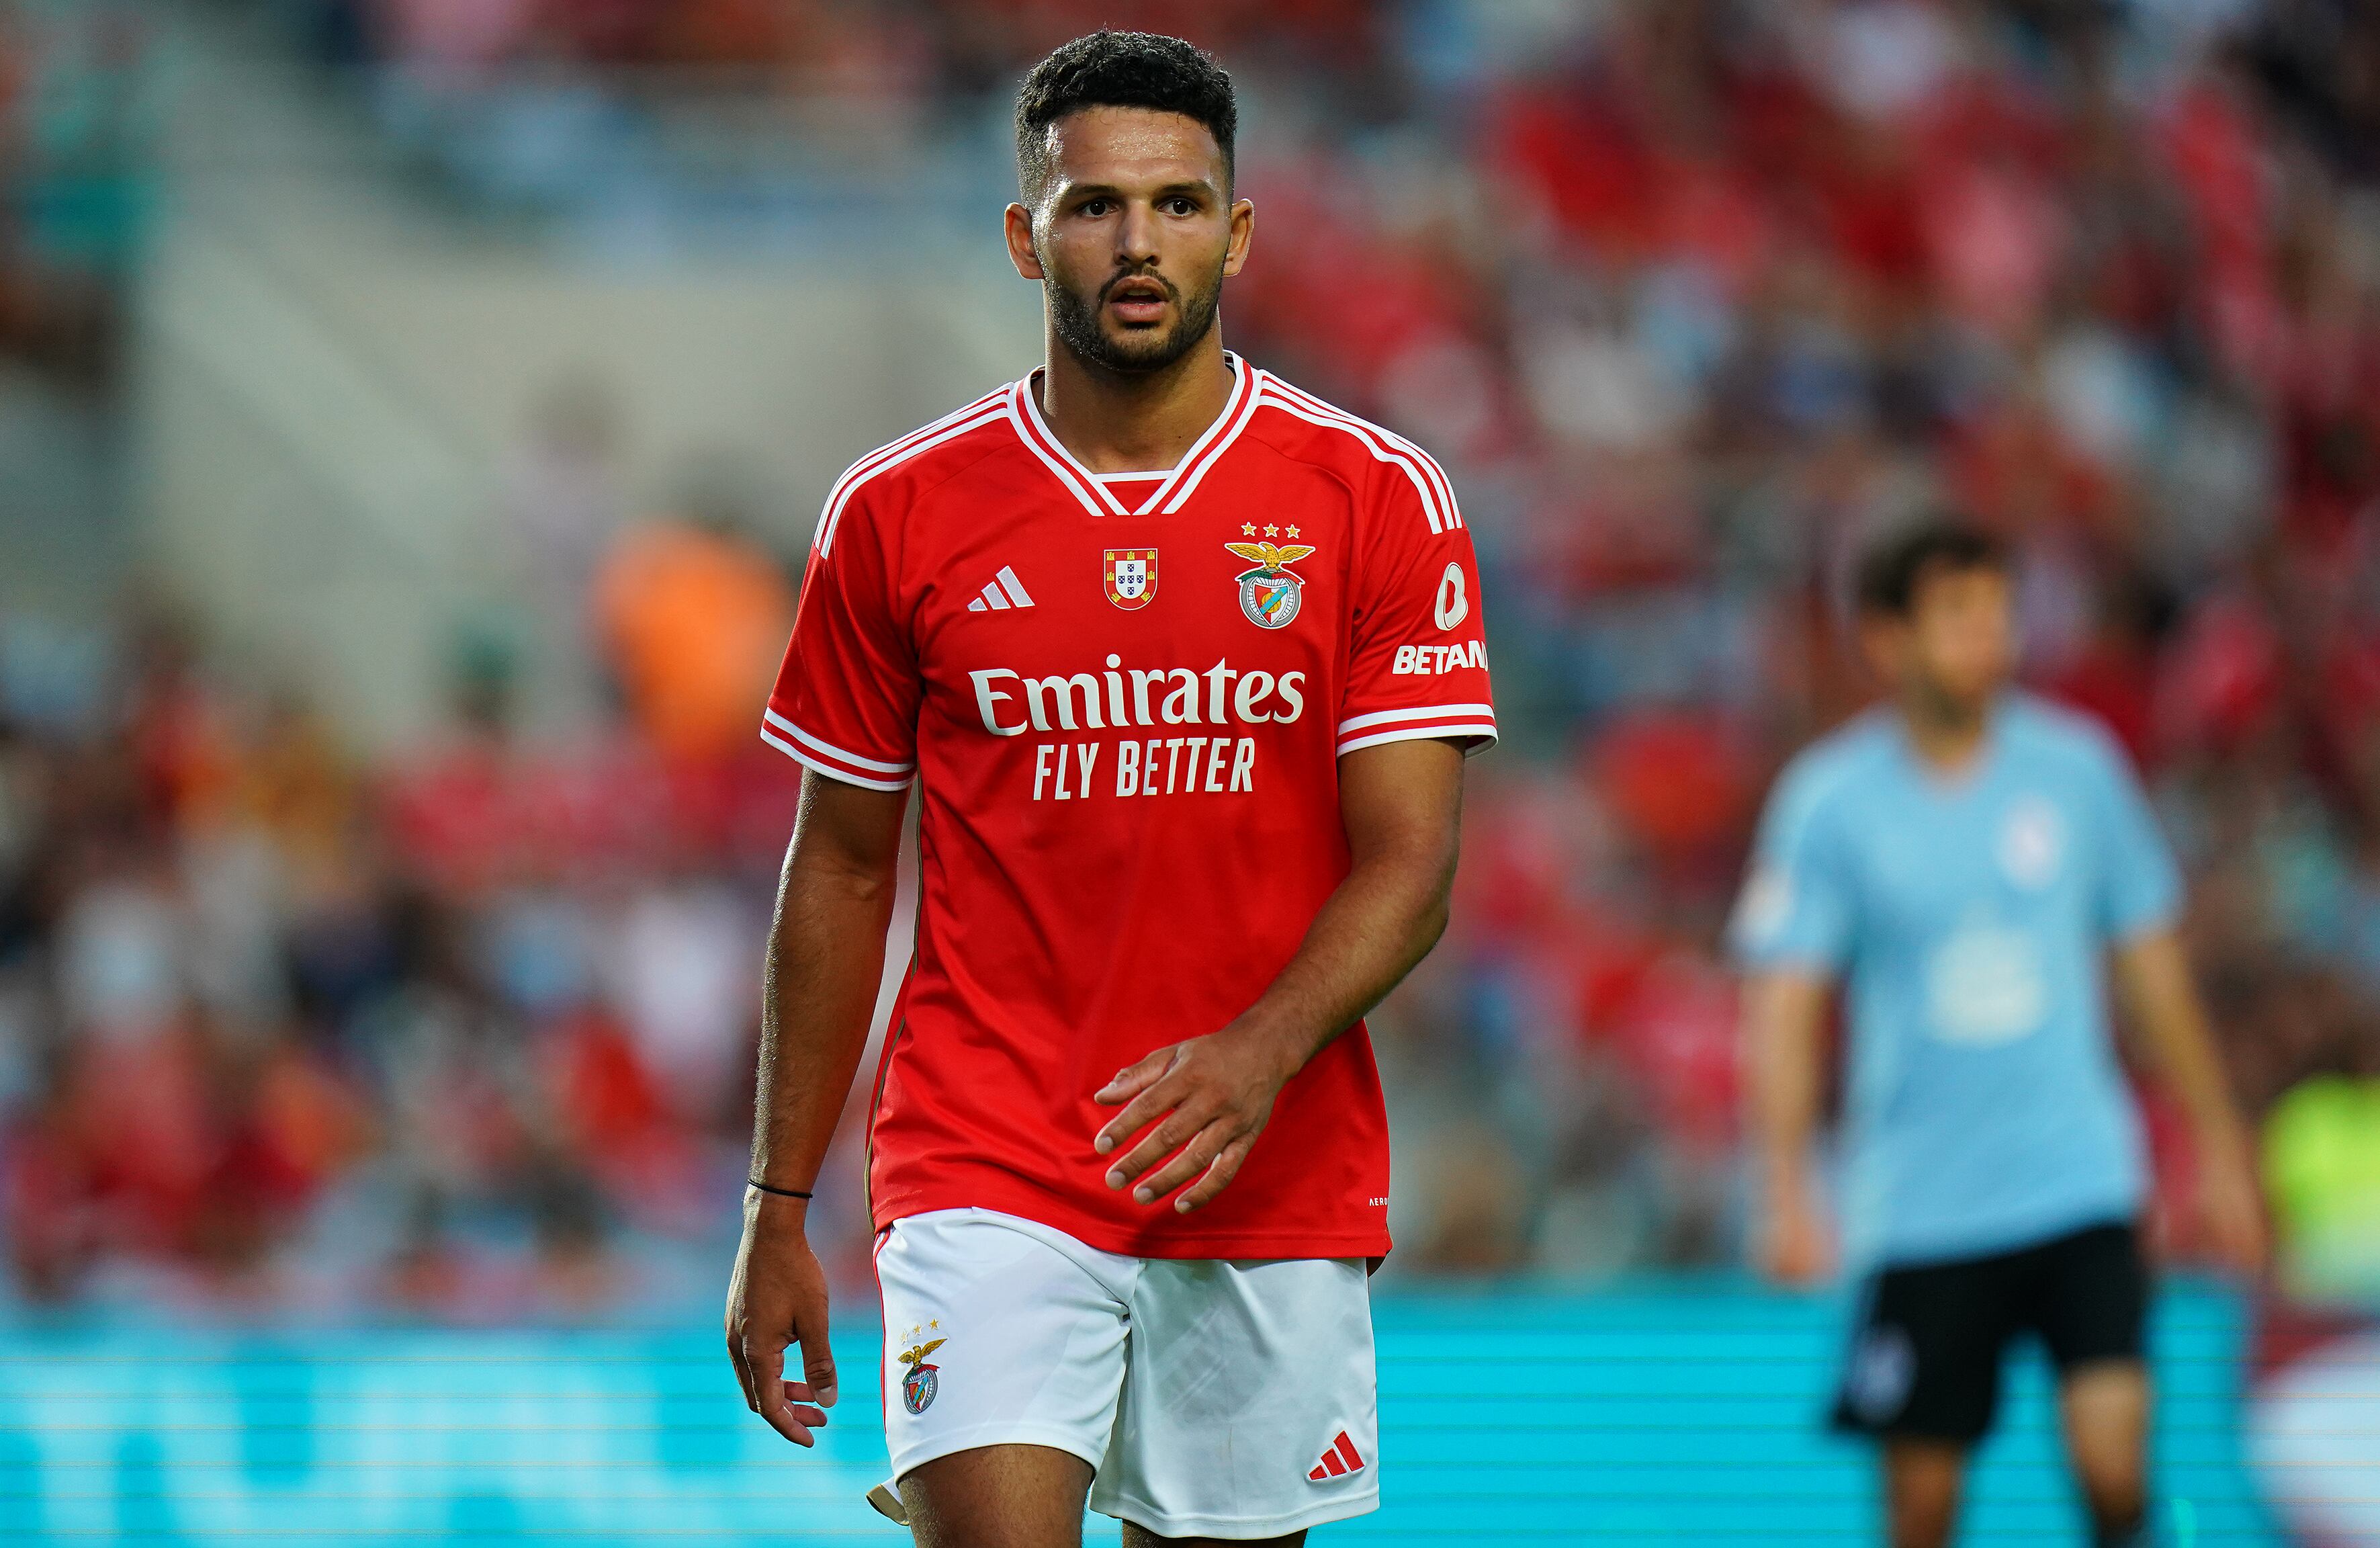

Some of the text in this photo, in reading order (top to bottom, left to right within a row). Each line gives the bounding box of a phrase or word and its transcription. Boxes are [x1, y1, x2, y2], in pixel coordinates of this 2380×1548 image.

[1392, 640, 1489, 675] BETAN
[967, 653, 1306, 736] Emirates
[1033, 736, 1255, 801] FLY BETTER
